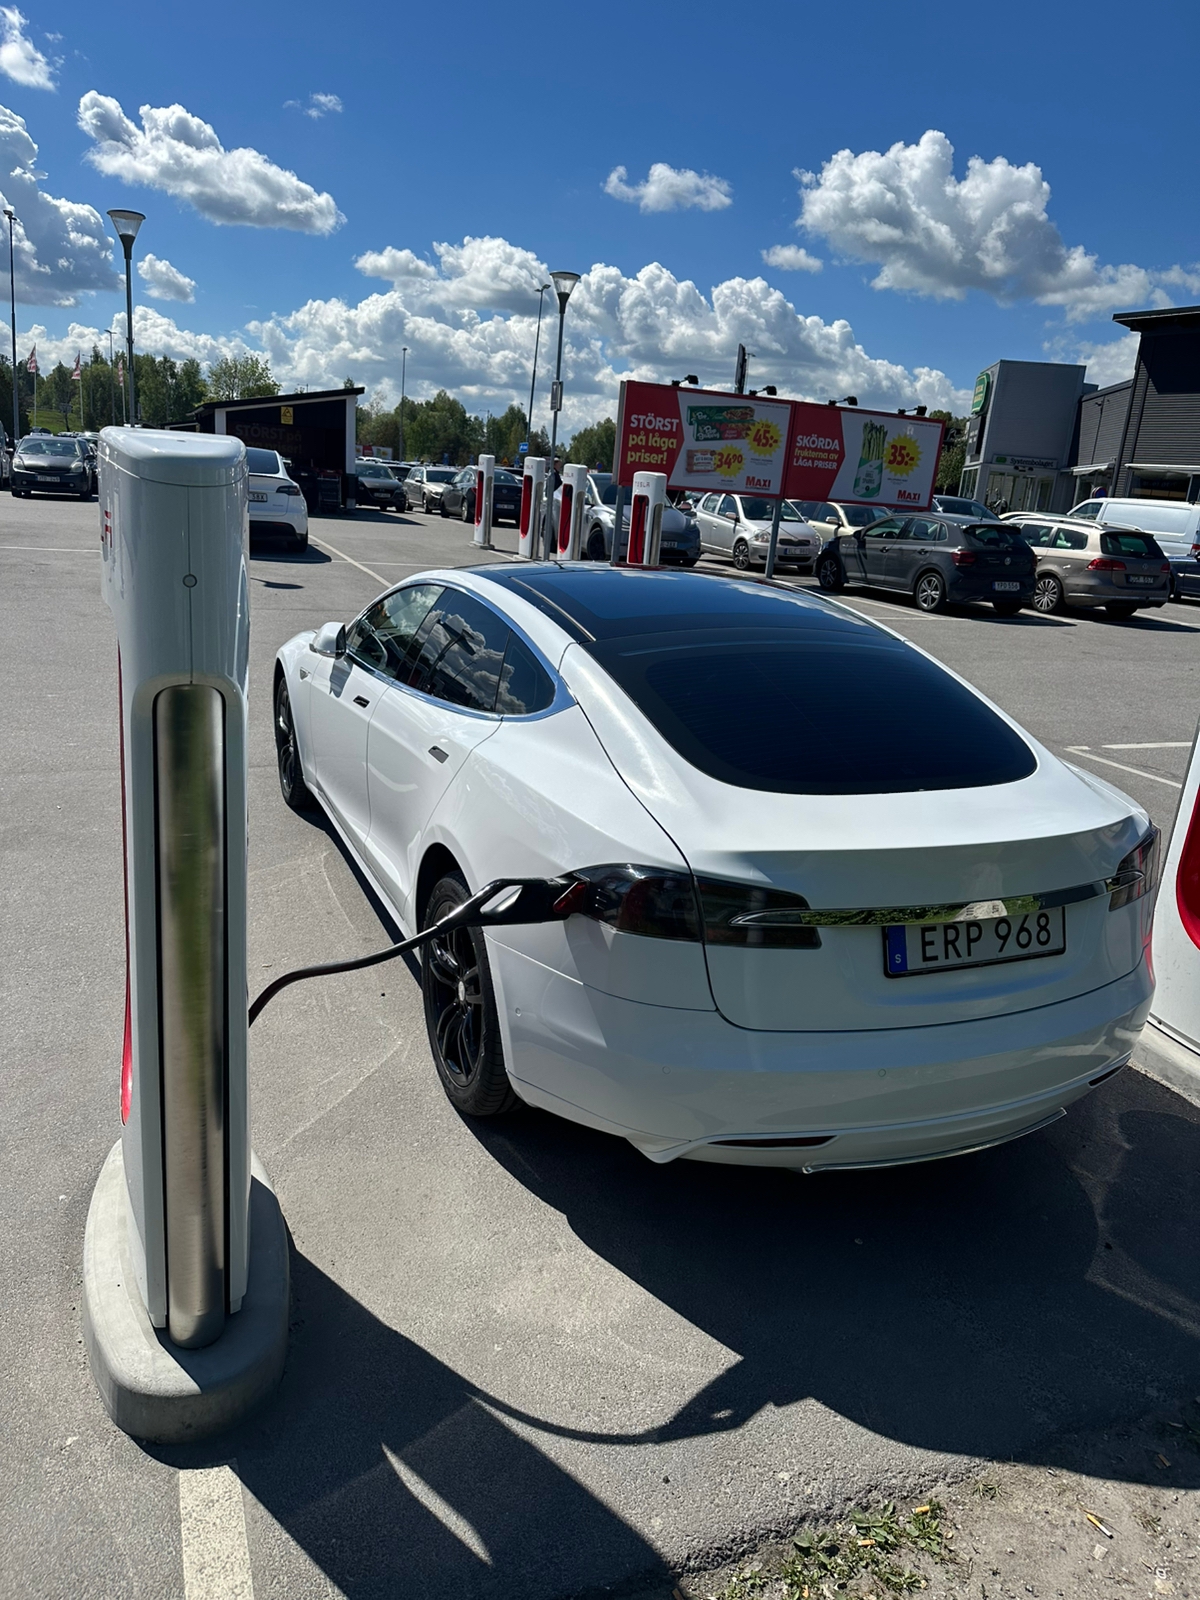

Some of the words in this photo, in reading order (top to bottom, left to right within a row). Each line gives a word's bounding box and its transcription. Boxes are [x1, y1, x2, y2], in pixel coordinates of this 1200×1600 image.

[630, 413, 679, 431] STÖRST
[628, 430, 646, 447] på
[648, 432, 677, 451] låga
[796, 433, 839, 450] SKÖRDA
[627, 449, 667, 464] priser!
[794, 447, 828, 459] frukterna
[888, 444, 915, 467] 35:-
[793, 456, 812, 467] LÅGA
[813, 460, 837, 469] PRISER
[1010, 457, 1053, 467] Systembolaget
[745, 476, 771, 488] MAXI
[897, 489, 921, 501] MAXI
[920, 921, 983, 962] ERP
[995, 913, 1051, 953] 968
[895, 954, 902, 964] S
